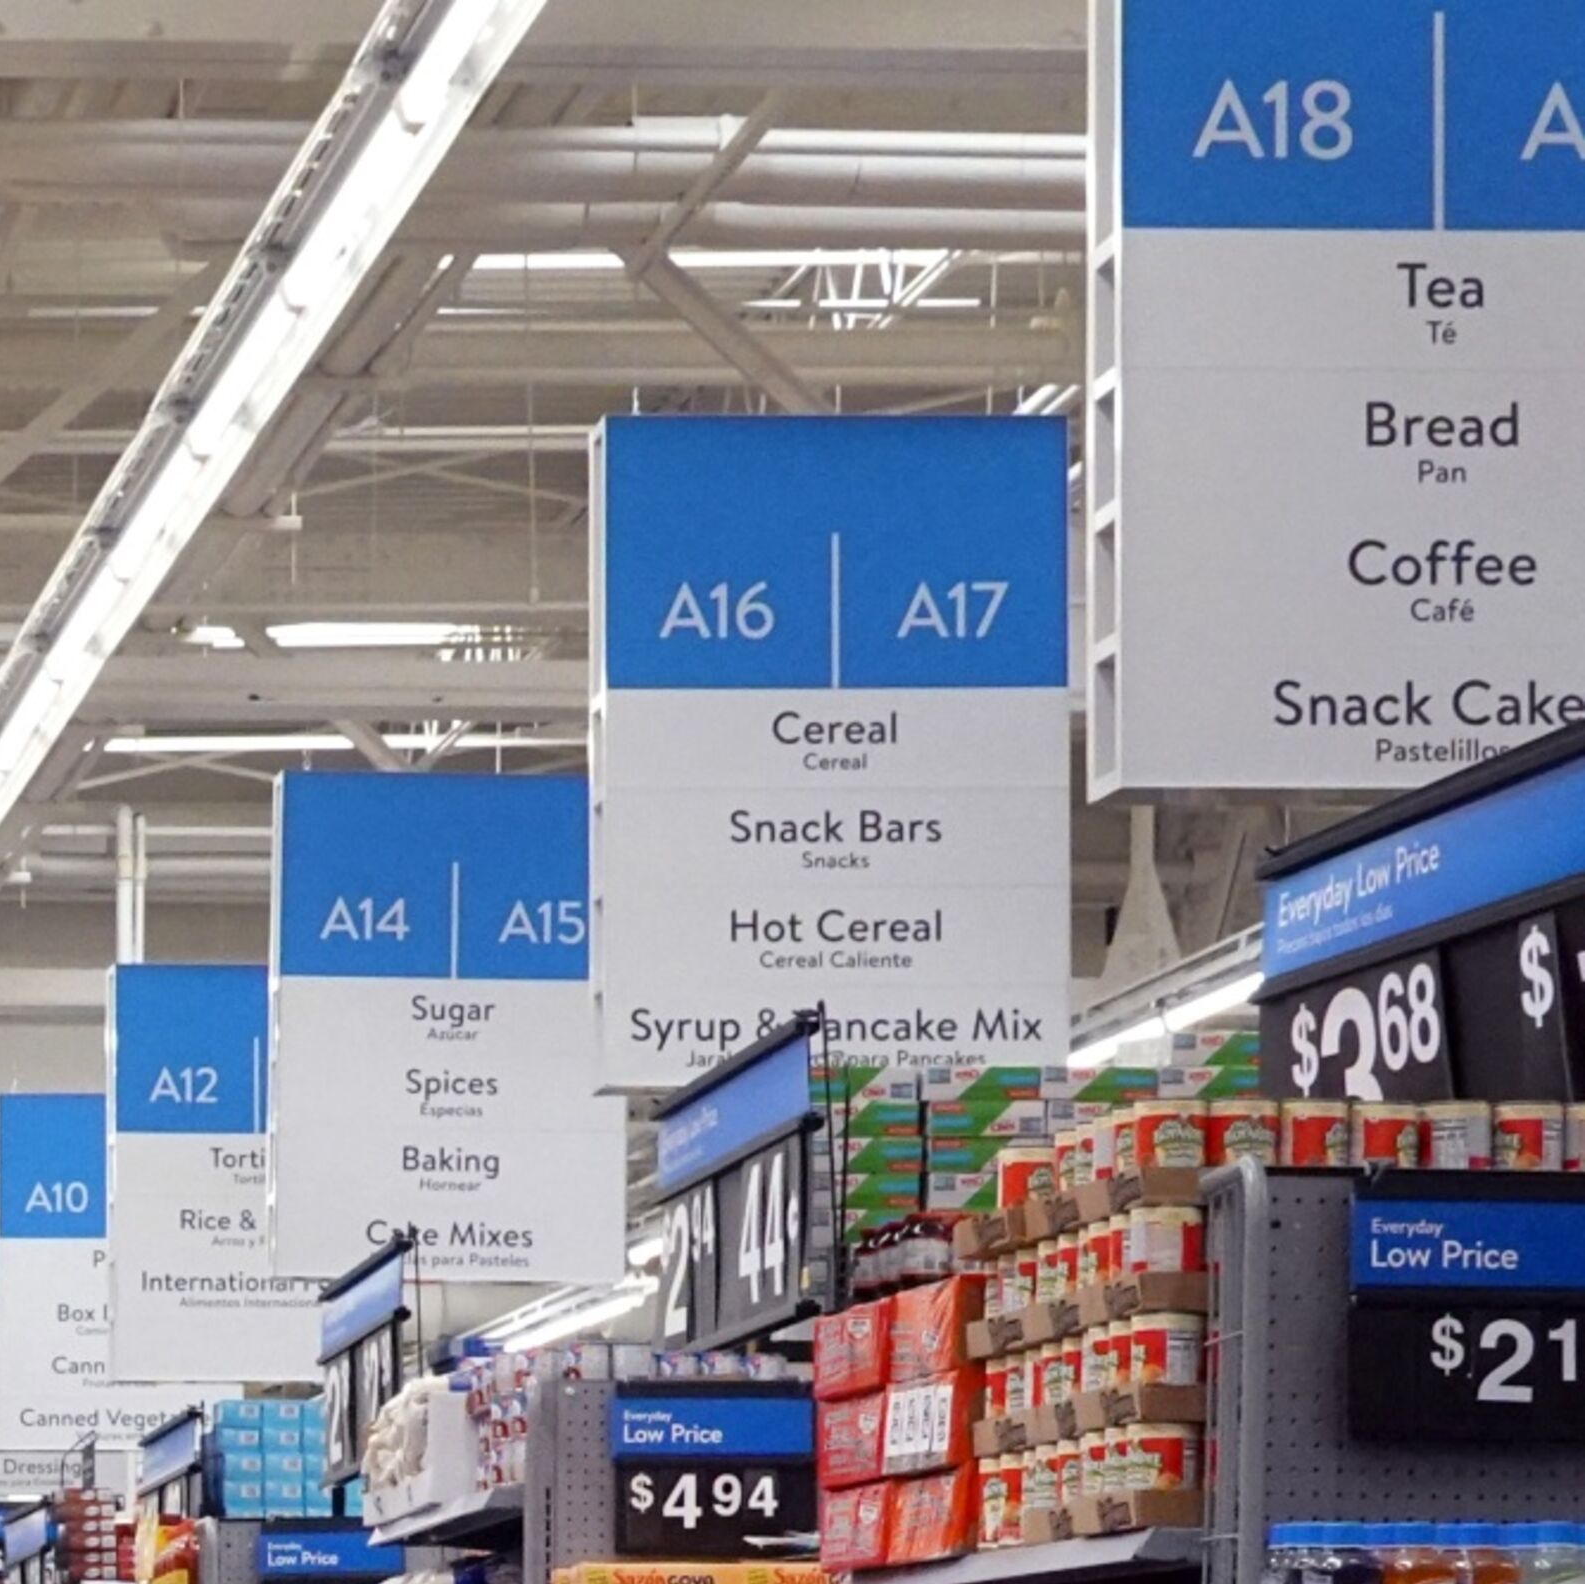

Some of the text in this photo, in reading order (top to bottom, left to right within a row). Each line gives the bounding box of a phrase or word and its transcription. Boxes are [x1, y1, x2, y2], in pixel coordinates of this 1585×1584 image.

[1192, 80, 1355, 161] A18
[1396, 263, 1486, 310] Tea
[1425, 321, 1458, 346] Té
[1365, 402, 1520, 450] Bread
[1418, 462, 1468, 485] Pan
[1347, 541, 1538, 588] Coffee
[659, 581, 1010, 640] A16 A17
[1411, 599, 1476, 624] Café
[1273, 680, 1431, 728] Snack
[772, 712, 898, 746] Cereal
[803, 754, 868, 771] Cereal
[730, 810, 943, 844] Snack Bars
[802, 852, 870, 870] Snacks
[1277, 842, 1440, 927] Everyday Low Price
[321, 897, 587, 945] A14 A15
[731, 910, 943, 943] Hot Cereal
[759, 952, 913, 969] Cereal Caliente
[411, 996, 496, 1028] Sugar
[631, 1008, 741, 1050] Syrup
[811, 1009, 959, 1042] ancake
[972, 1009, 1043, 1042] Mix
[150, 1067, 219, 1104] A12
[406, 1070, 499, 1102] Spices
[402, 1147, 501, 1180] Baking
[25, 1181, 89, 1214] A10
[179, 1209, 257, 1231] Rice &
[449, 1221, 534, 1248] Mixes
[1371, 1217, 1444, 1239] Everyday
[469, 1254, 530, 1268] Pasteles
[1371, 1238, 1519, 1270] Low Price
[58, 1303, 96, 1323] Box
[20, 1408, 100, 1427] Canned
[624, 1410, 673, 1423] Everyday
[623, 1424, 723, 1445] Low Price
[267, 1551, 339, 1567] Low Price
